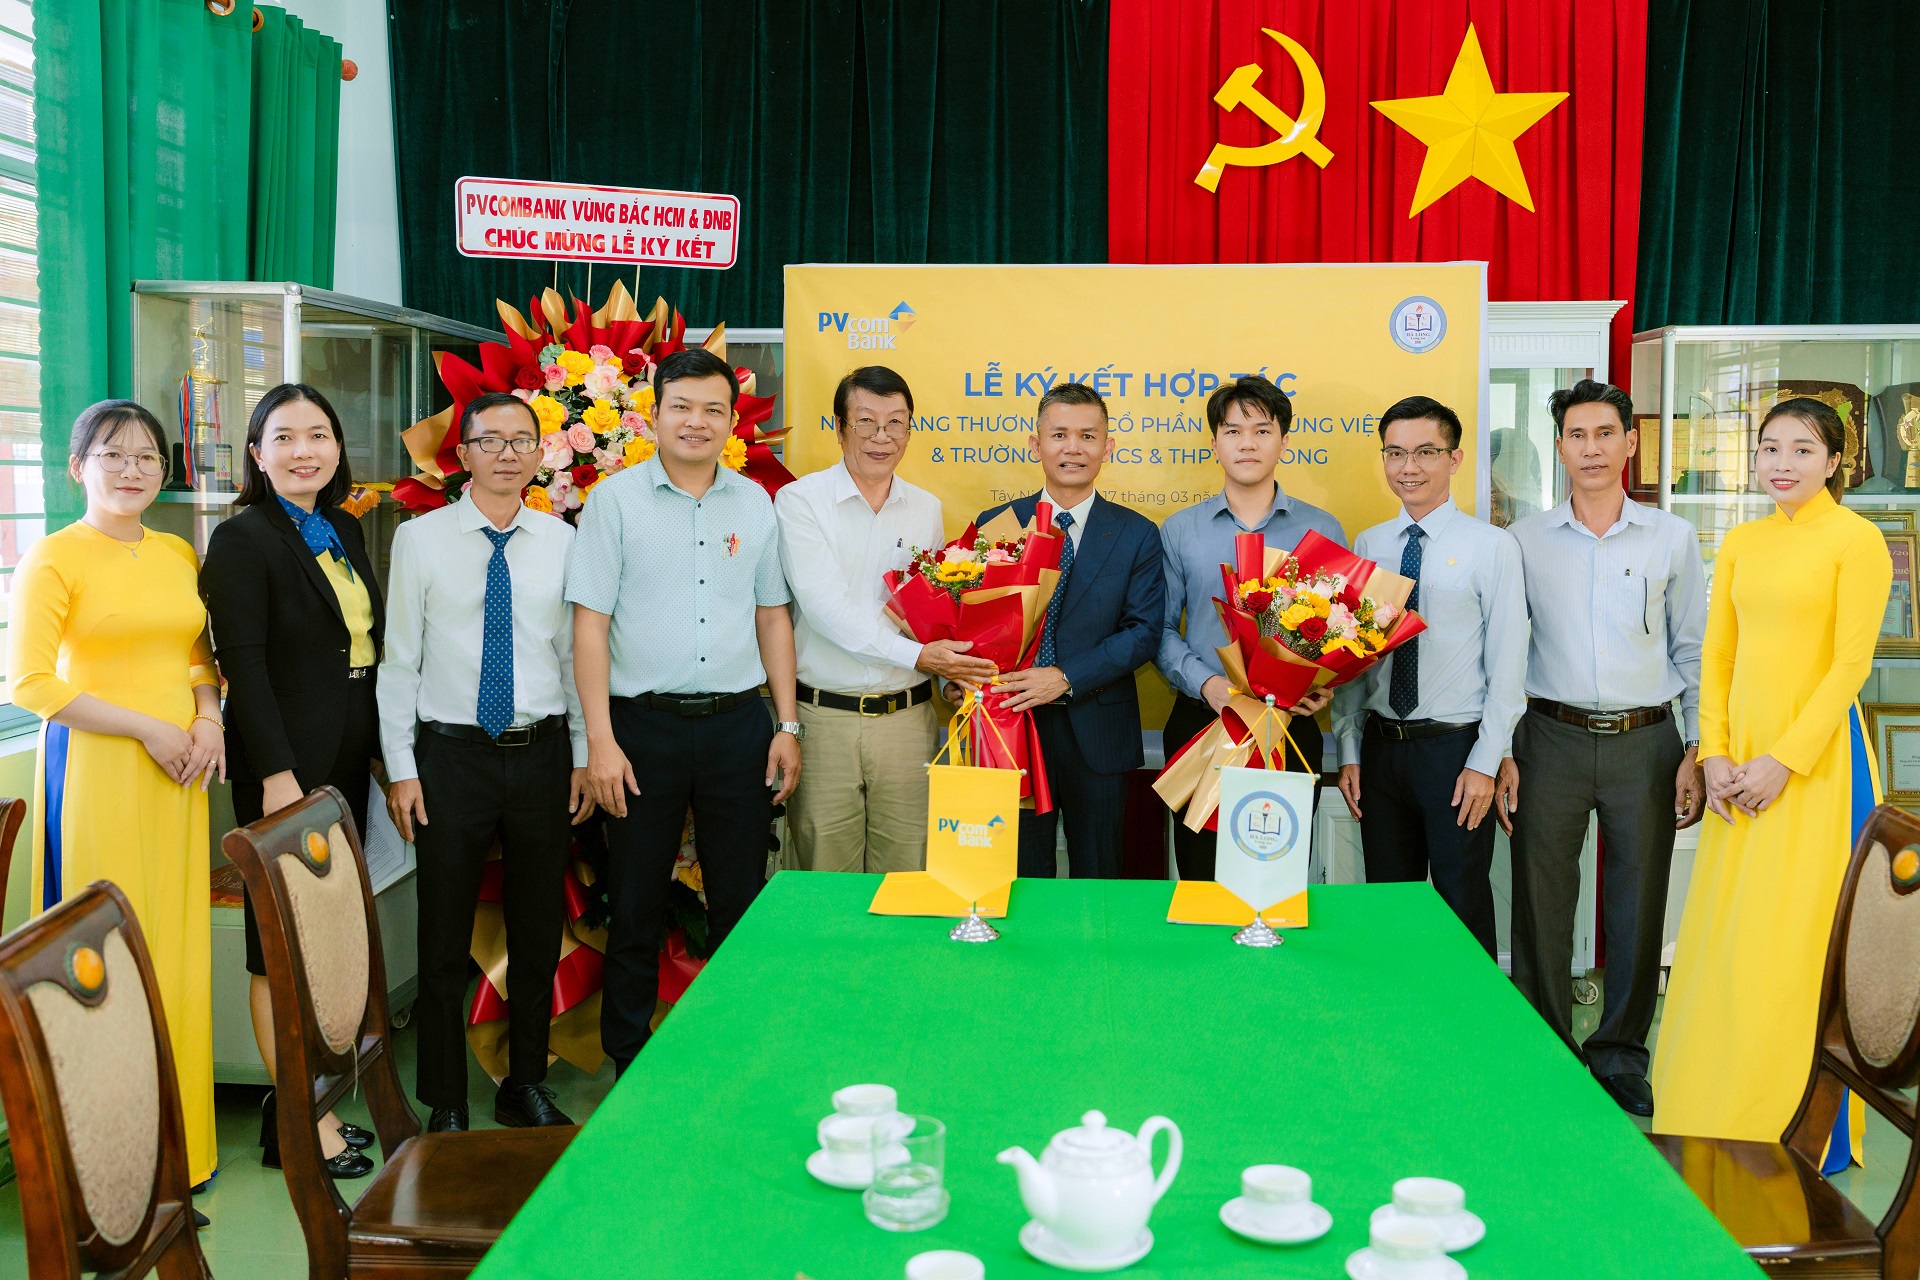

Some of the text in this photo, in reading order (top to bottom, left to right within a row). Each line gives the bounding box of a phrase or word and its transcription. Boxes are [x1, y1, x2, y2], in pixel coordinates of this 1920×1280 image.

[466, 193, 732, 231] PVCOMBANK VÙNG BẮC HCM & ĐNB
[484, 226, 716, 260] CHÚC MỪNG LỄ KÝ KẾT
[965, 361, 1003, 397] LỄ
[1015, 366, 1058, 397] KÝ
[1144, 368, 1220, 404] HỢP
[957, 413, 1041, 432] THƯƠN
[1107, 411, 1134, 433] CỔ
[1141, 411, 1202, 433] PHẦN
[1288, 413, 1333, 433] ÚNG
[931, 447, 945, 463] &
[1149, 448, 1163, 464] &
[1278, 449, 1328, 465] ONG
[1102, 490, 1117, 502] 17
[1121, 490, 1166, 506] tháng
[1170, 491, 1189, 503] 03
